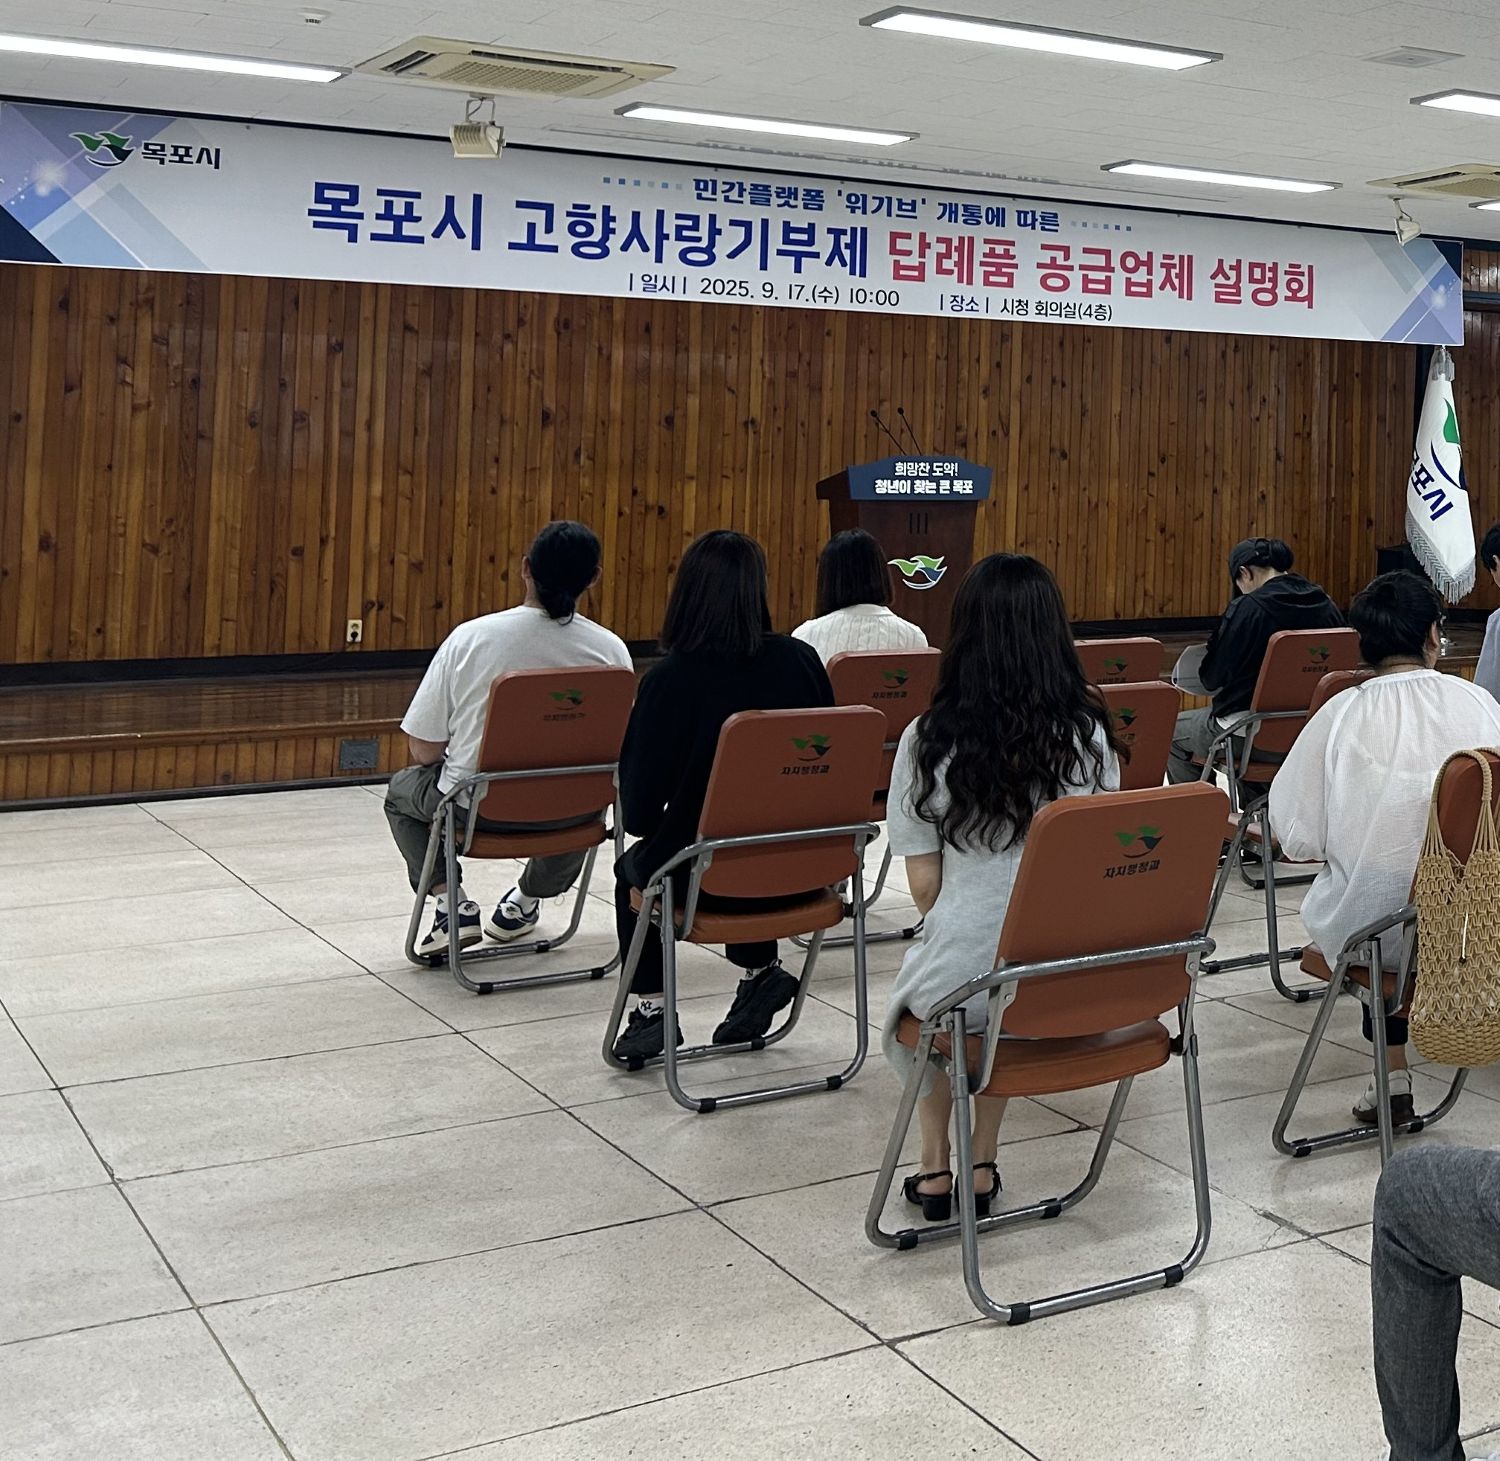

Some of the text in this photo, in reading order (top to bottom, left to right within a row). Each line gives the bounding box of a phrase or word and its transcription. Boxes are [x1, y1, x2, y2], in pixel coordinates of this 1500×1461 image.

[141, 141, 221, 170] 목포시
[693, 177, 825, 212] 민간플랫폼
[936, 201, 1006, 228] 개통에
[1015, 209, 1060, 233] 따른
[307, 181, 1314, 310] 목포시 고향사랑기부제 답례품 공급업체 설명회
[850, 288, 900, 307] 10:00
[1000, 298, 1029, 316] 시청
[1034, 300, 1113, 321] 회의실(4층)
[894, 461, 959, 478] 희망찬 도약!
[874, 479, 974, 495] 청년이 찾는 큰 목포
[1411, 450, 1454, 522] 포시
[1103, 859, 1161, 880] 자치행정과
